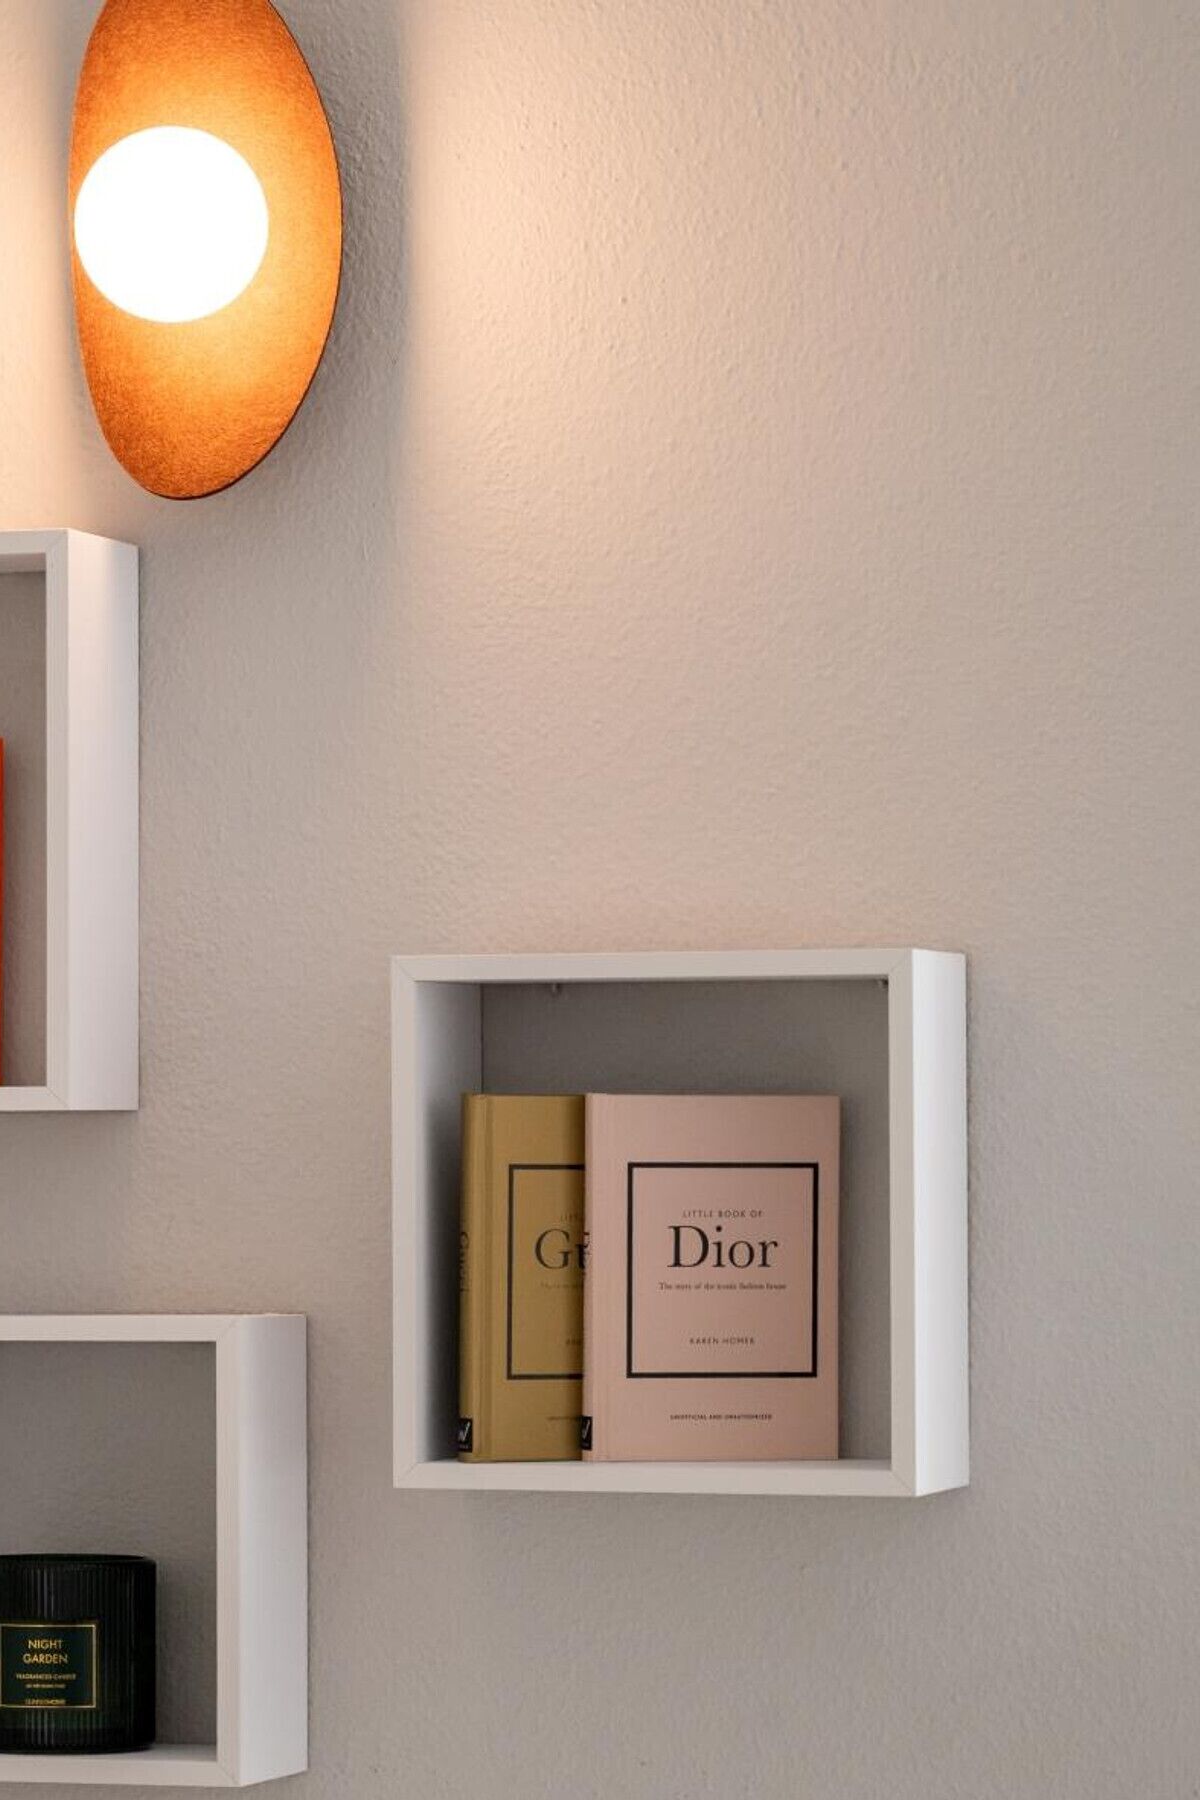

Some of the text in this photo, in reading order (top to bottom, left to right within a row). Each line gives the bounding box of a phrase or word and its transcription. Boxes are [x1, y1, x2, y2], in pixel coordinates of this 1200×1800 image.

[683, 1210, 763, 1218] LITTLE BOOK OF
[667, 1225, 779, 1269] Dior
[689, 1337, 754, 1345] KAREN HOMER
[28, 1639, 63, 1649] NIGHT
[23, 1653, 68, 1665] GARDEN
